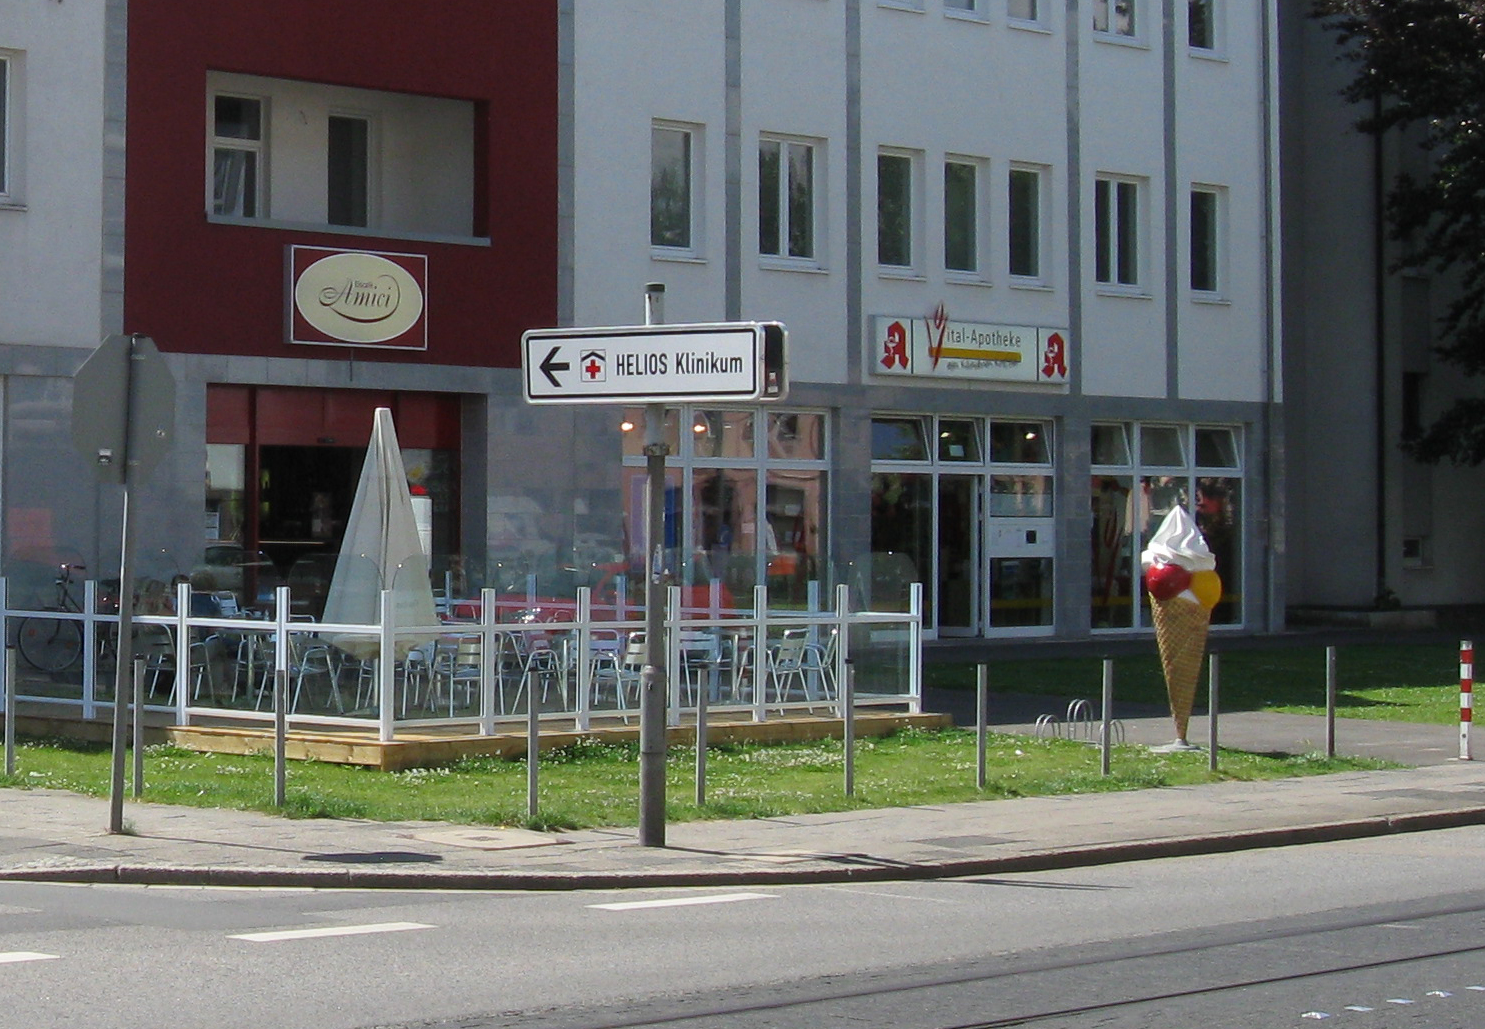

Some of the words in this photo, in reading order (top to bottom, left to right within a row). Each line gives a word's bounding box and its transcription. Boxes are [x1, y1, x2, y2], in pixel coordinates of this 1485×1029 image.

[319, 275, 400, 319] Amici
[616, 353, 667, 376] HELIOS
[676, 351, 743, 375] Klinikum
